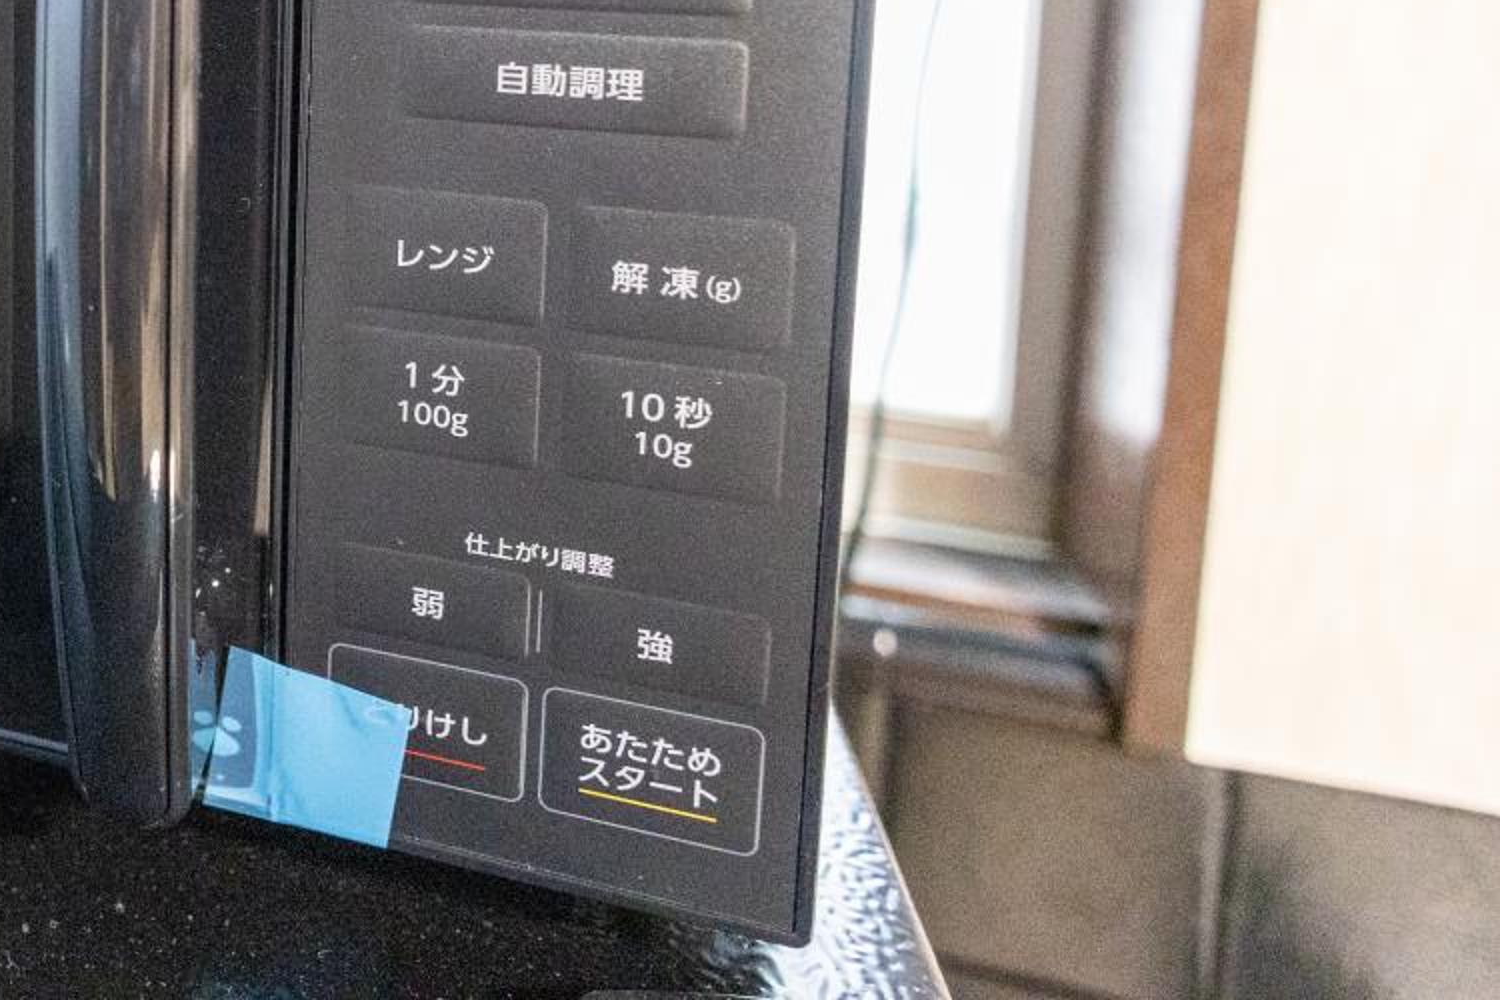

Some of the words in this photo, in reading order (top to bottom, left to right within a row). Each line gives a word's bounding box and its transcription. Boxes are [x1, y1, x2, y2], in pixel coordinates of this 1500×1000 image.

[496, 61, 645, 101] 自動調理
[396, 239, 495, 274] レンジ
[398, 400, 469, 438] 100g
[635, 431, 693, 468] 10g
[464, 531, 615, 579] 仕上がり調整
[411, 586, 445, 621] 弱
[636, 627, 674, 665] 強
[408, 705, 488, 746] りけし
[580, 723, 721, 777] あたため
[578, 755, 719, 809] スタート
